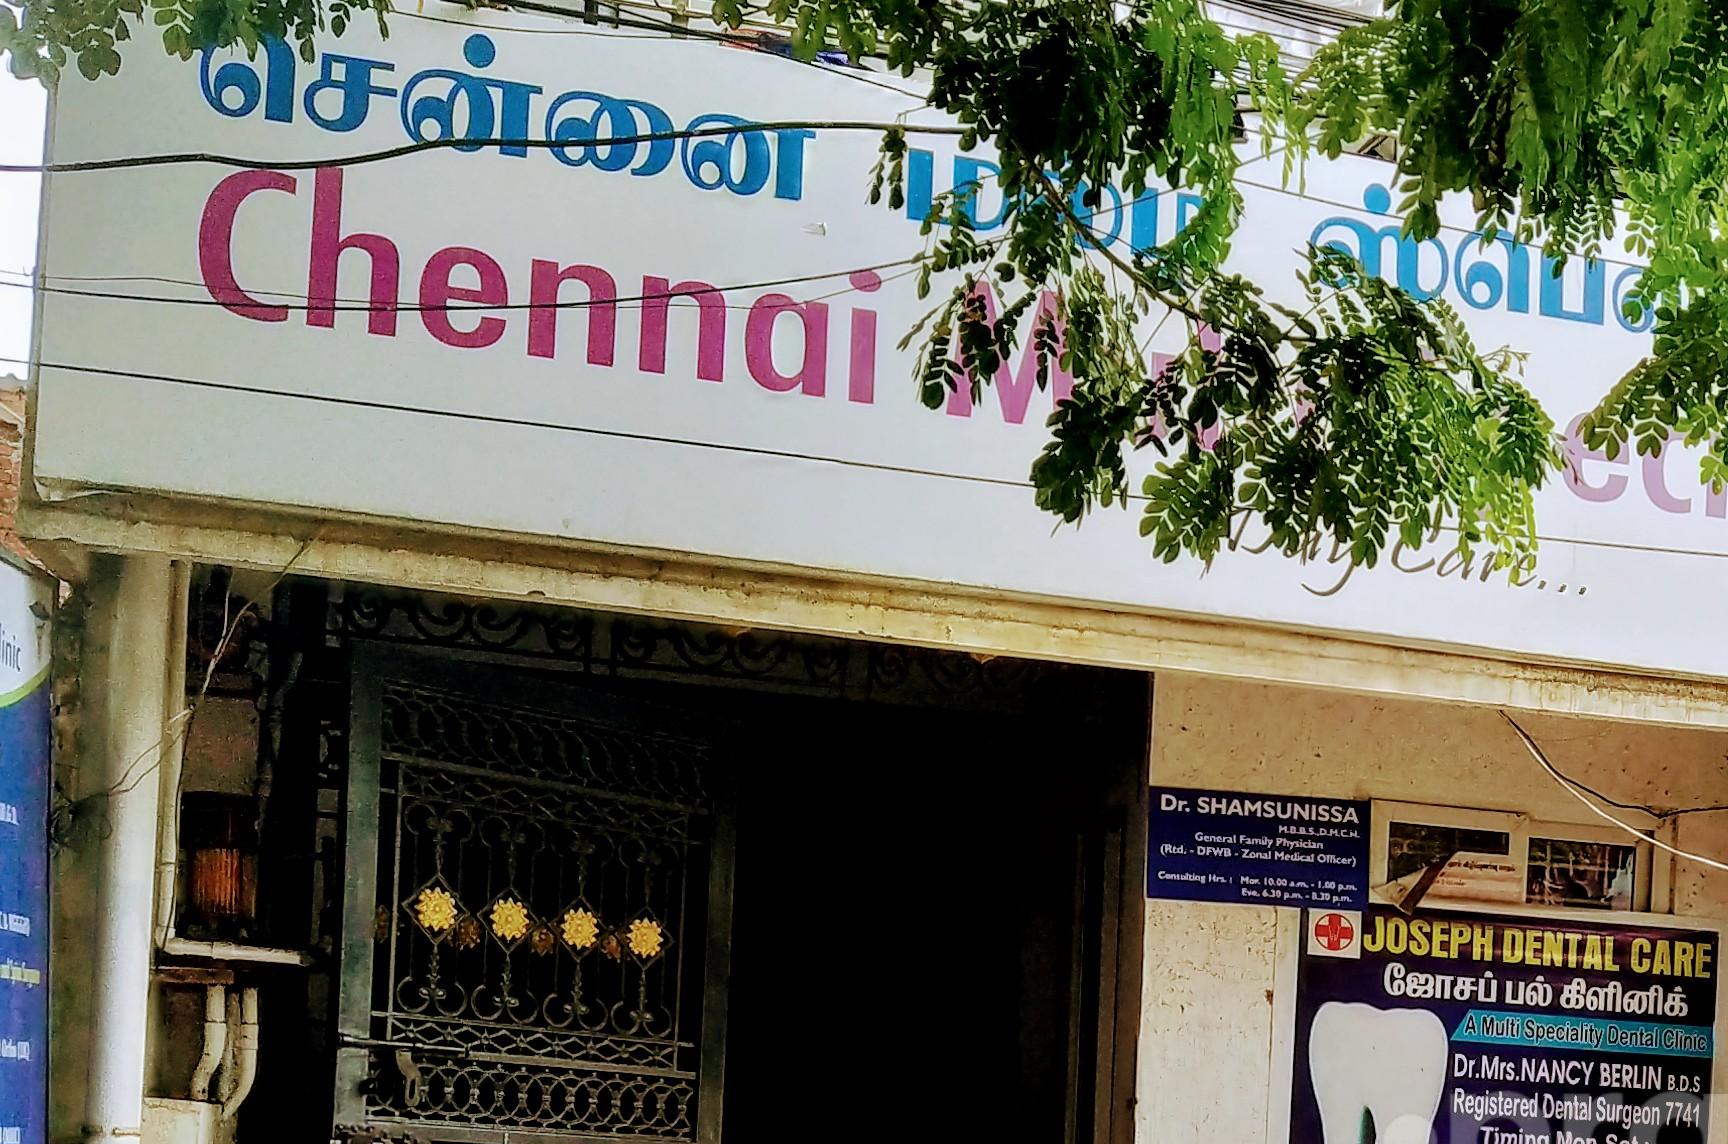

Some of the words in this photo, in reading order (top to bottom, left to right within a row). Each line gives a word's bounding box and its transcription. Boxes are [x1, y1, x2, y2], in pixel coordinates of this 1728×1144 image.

[201, 32, 816, 200] சென்னை
[199, 167, 882, 404] Chennai
[1160, 794, 1190, 814] Dr.
[1197, 797, 1360, 824] SHAMSUNISSA
[1160, 843, 1187, 856] (Rtd.
[1197, 846, 1232, 858] DFWB
[1242, 849, 1271, 860] Zonal
[1275, 851, 1314, 863] Medical
[1317, 853, 1357, 867] Officer)
[1195, 832, 1237, 845] General
[1239, 835, 1273, 848] Family
[1275, 838, 1324, 850] Physician
[1158, 871, 1206, 884] Consulting
[1264, 877, 1288, 887] 10.00
[1363, 915, 1494, 961] JOSEPH
[1502, 927, 1620, 972] DENTAL
[1631, 938, 1712, 978] CARE
[1383, 962, 1498, 1004] ஜோசப்
[1505, 975, 1552, 1008] பல்
[1559, 977, 1689, 1018] கிளினிக்
[1464, 1015, 1477, 1034] A
[1482, 1017, 1520, 1038] Multi
[1524, 1021, 1603, 1047] Speciality
[1607, 1026, 1659, 1048] Dental
[1663, 1029, 1707, 1051] Clinic
[1453, 1053, 1594, 1086] Dr.Mrs.NANCY
[1600, 1062, 1662, 1090] BERLIN
[1668, 1074, 1701, 1092] B.D.S
[1453, 1088, 1538, 1121] Registered
[1543, 1093, 1592, 1121] Dental
[1596, 1097, 1660, 1129] Surgeon
[1665, 1101, 1701, 1128] 7741
